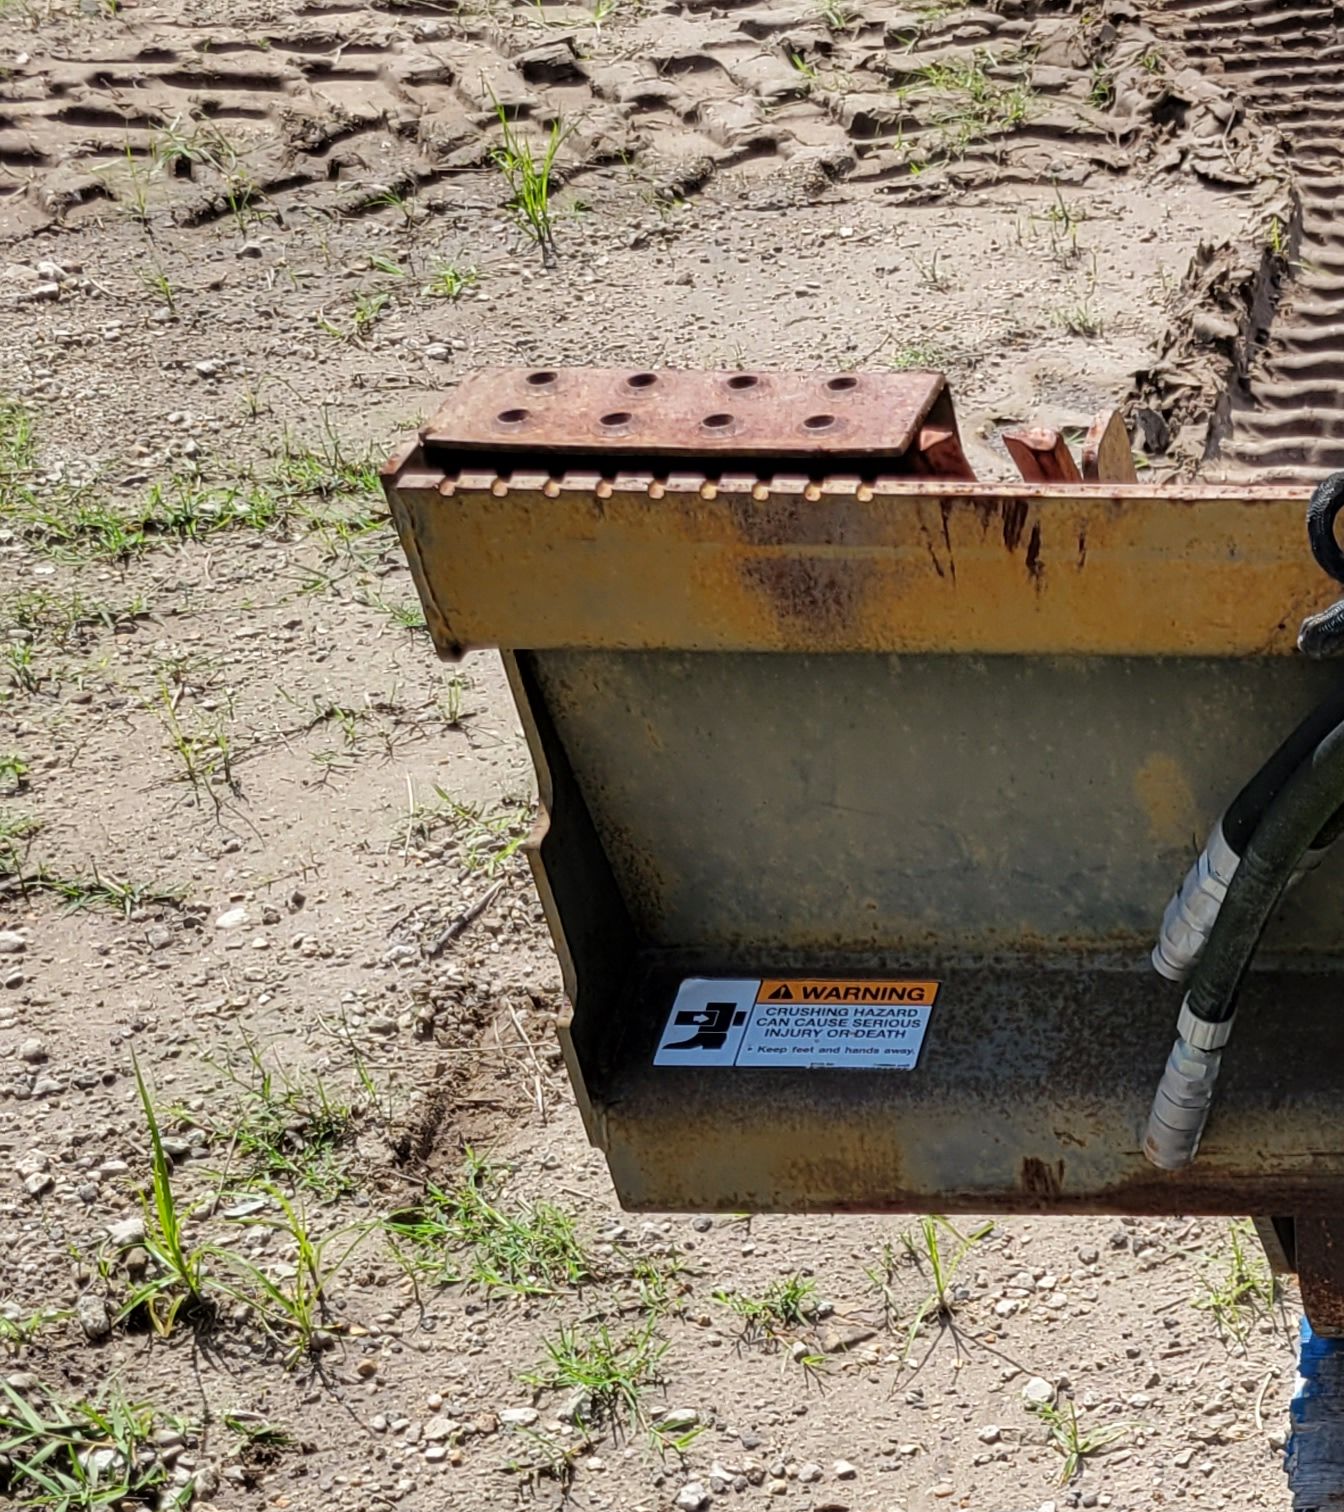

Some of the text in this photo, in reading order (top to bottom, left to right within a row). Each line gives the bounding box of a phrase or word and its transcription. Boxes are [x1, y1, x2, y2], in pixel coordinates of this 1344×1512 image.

[802, 986, 925, 1001] WARNING
[765, 1007, 918, 1018] CRUSHING HAZARD
[756, 1018, 922, 1028] CAN CAUSE SERIOUS
[764, 1028, 907, 1039] INJURY OR DEATH
[757, 1045, 787, 1055] Keep
[792, 1045, 814, 1054] feet
[818, 1046, 842, 1055] and
[844, 1046, 879, 1055] hands
